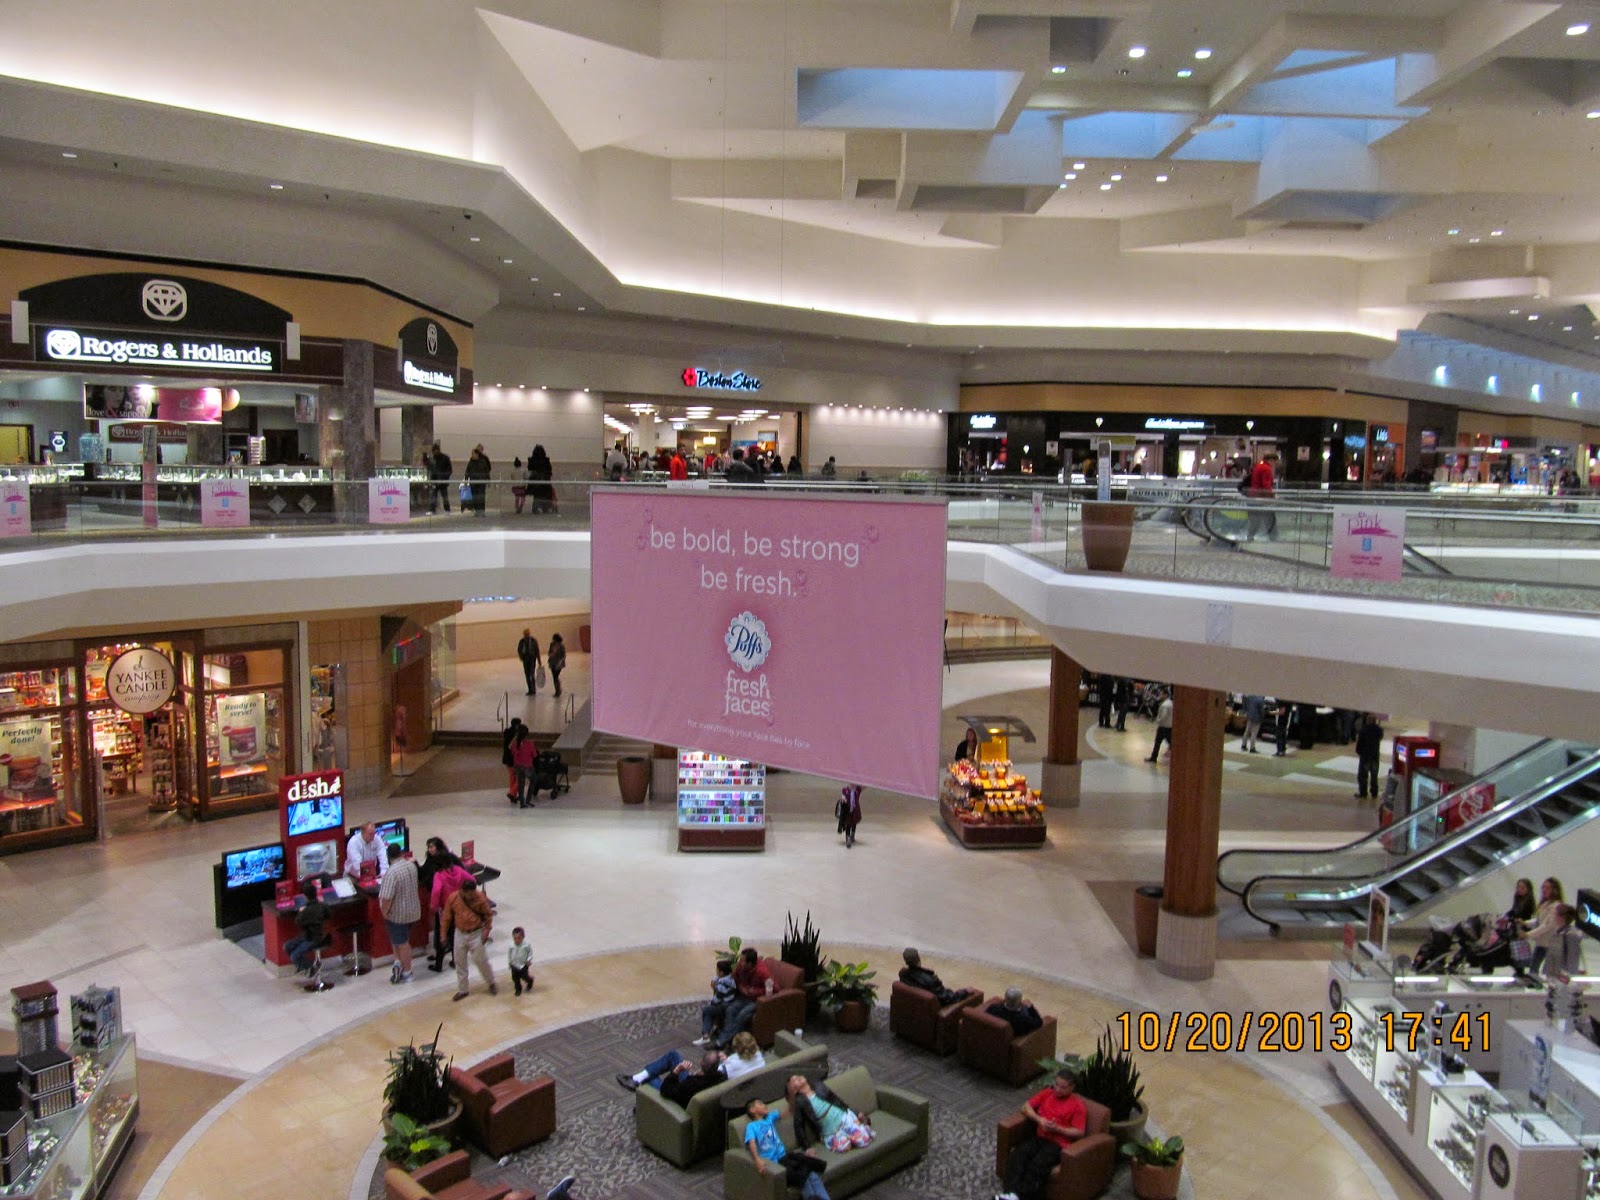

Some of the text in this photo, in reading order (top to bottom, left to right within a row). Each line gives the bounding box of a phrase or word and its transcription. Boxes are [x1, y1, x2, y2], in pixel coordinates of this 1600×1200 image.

[82, 337, 273, 364] Rogers & Hollands
[651, 525, 859, 568] be bold, be strong
[701, 564, 797, 597] be fresh.
[731, 624, 763, 660] Puffs
[116, 670, 168, 683] YANKEE
[116, 681, 168, 695] CANDLE
[726, 669, 771, 699] fresh
[225, 702, 249, 710] Ready
[724, 688, 771, 717] faces
[2, 727, 43, 737] Perfectly
[11, 736, 36, 744] done!
[288, 776, 331, 802] dish
